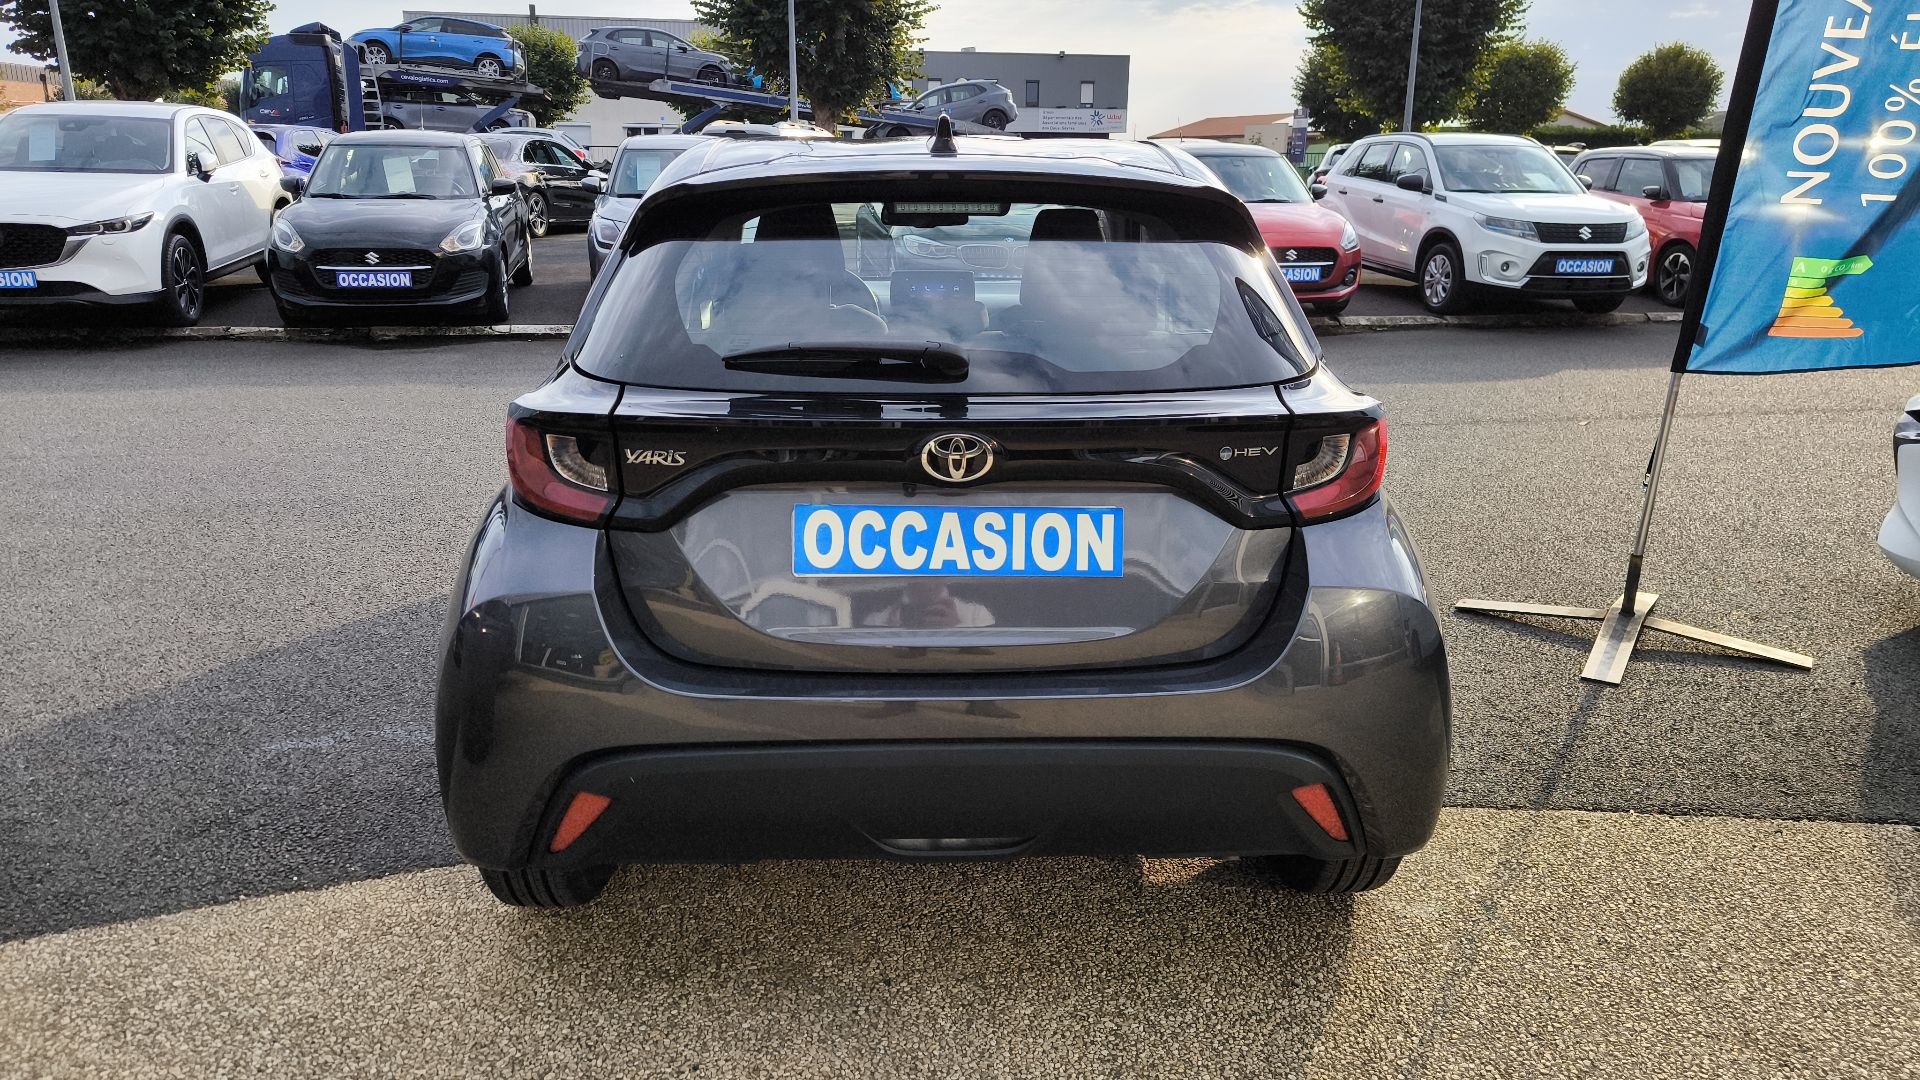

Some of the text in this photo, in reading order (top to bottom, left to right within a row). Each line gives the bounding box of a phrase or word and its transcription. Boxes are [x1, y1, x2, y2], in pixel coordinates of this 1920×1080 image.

[400, 74, 449, 85] cevalogistics.com
[1861, 78, 1920, 207] 100%
[1558, 260, 1613, 273] OCCASION
[1794, 261, 1806, 273] A
[338, 273, 411, 287] OCCASION
[1234, 446, 1279, 457] HEV
[803, 509, 1115, 572] OCCASION
